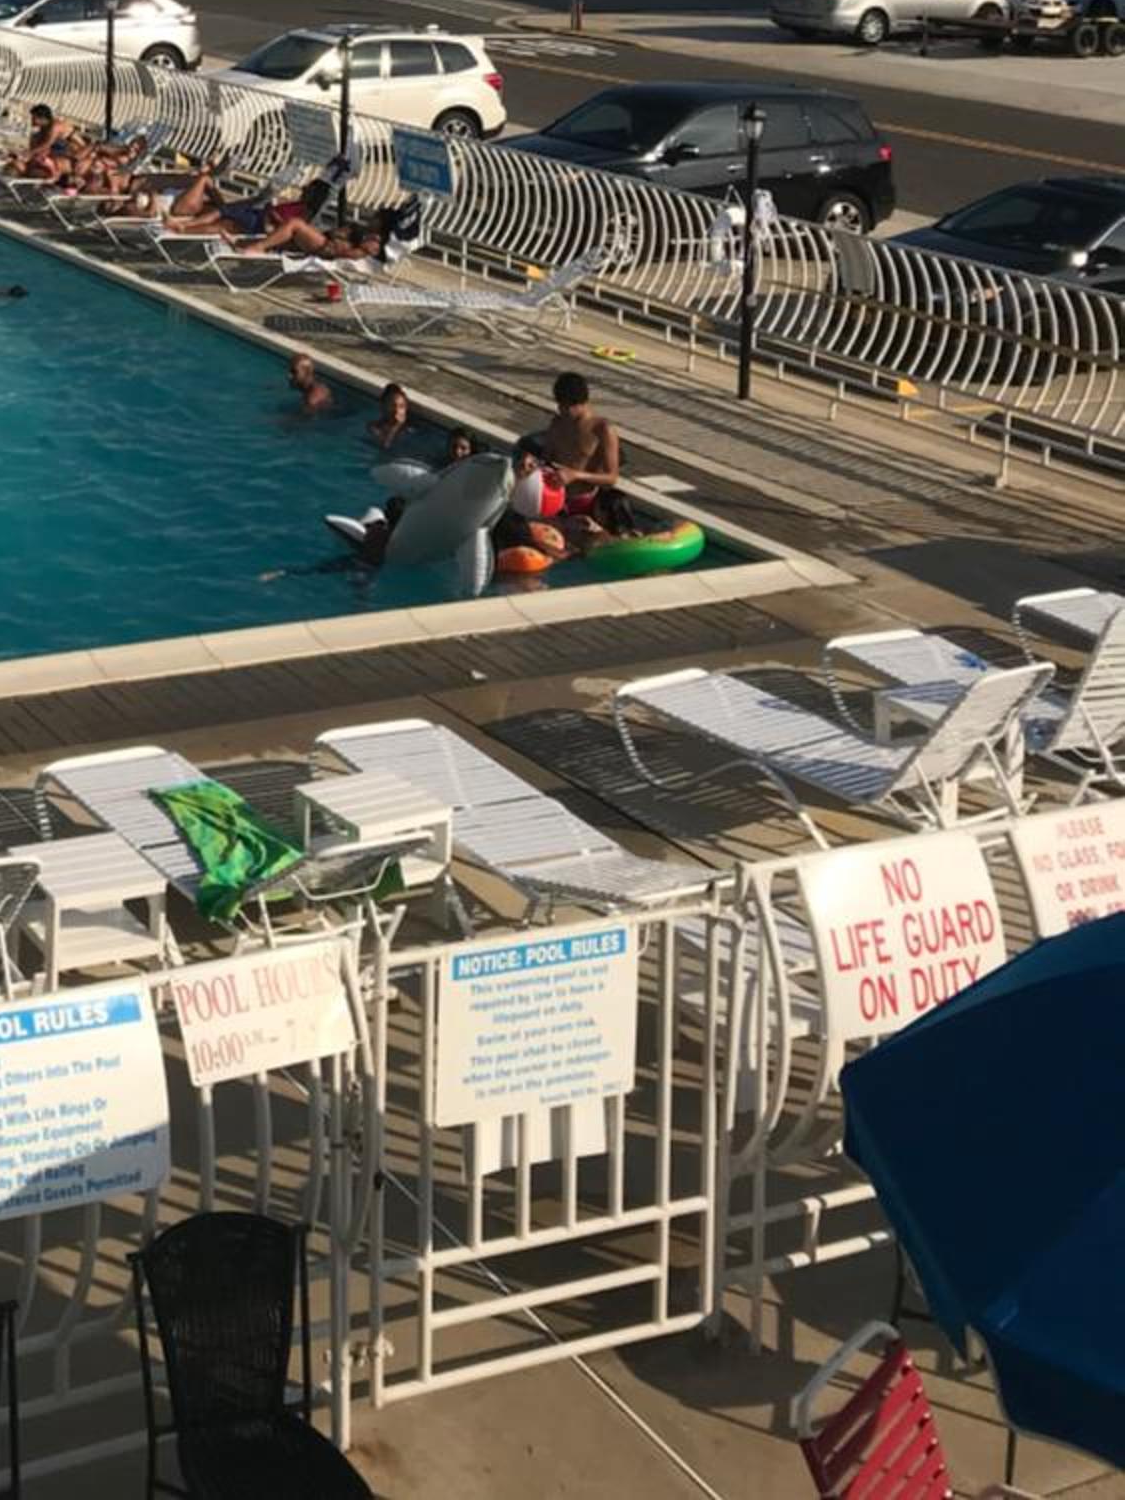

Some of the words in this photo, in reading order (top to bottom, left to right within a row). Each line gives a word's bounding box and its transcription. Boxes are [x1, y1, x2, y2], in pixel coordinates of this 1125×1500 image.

[1056, 817, 1105, 839] PLEASE
[1032, 853, 1053, 872] NO
[881, 857, 923, 906] NO
[1056, 881, 1076, 902] OR
[1079, 874, 1121, 898] DRINK
[829, 919, 892, 973] LIFE
[903, 899, 995, 959] GUARD
[458, 949, 523, 976] NOTICE:
[525, 942, 567, 966] POOL
[570, 932, 621, 959] RULES
[176, 974, 251, 1025] POOL
[252, 952, 339, 1008] HOURS
[858, 973, 899, 1022] ON
[909, 955, 981, 1013] DUTY
[32, 1001, 109, 1034] RULES
[190, 1031, 245, 1075] 10:00
[4, 1070, 43, 1086] Others
[72, 1059, 92, 1074] The
[95, 1054, 121, 1071] Pool
[5, 1110, 32, 1127] With
[34, 1107, 56, 1122] Life
[59, 1103, 91, 1119] Rings
[92, 1097, 108, 1111] Or
[22, 1147, 73, 1165] Standing
[75, 1141, 93, 1157] On
[94, 1137, 109, 1153] Or
[109, 1129, 157, 1151] Jumping
[42, 1121, 104, 1142] Equipment
[16, 1170, 45, 1187] Pool
[45, 1163, 85, 1181] Railing
[43, 1182, 85, 1202] Guests
[86, 1168, 143, 1194] Permitted
